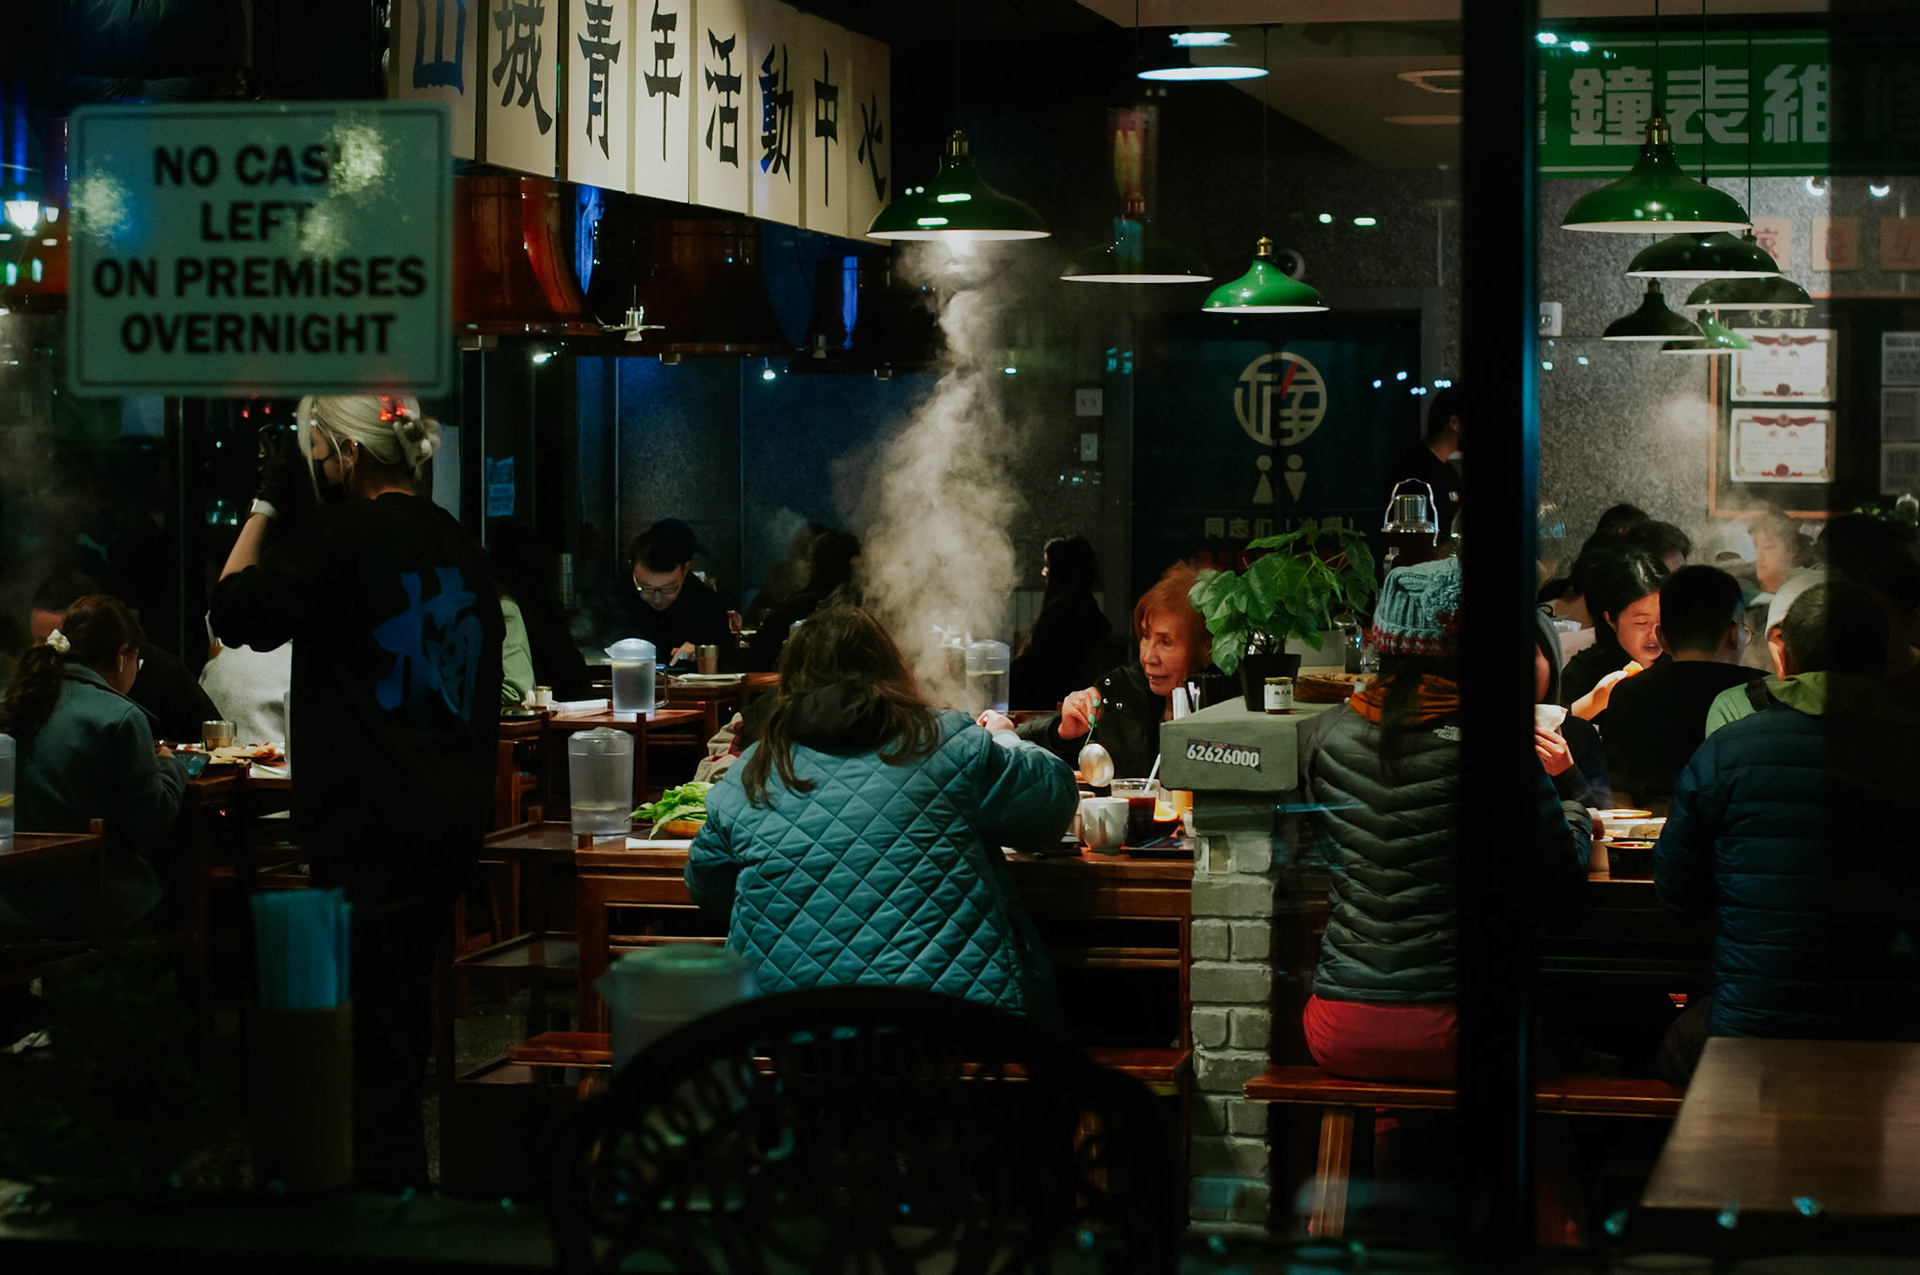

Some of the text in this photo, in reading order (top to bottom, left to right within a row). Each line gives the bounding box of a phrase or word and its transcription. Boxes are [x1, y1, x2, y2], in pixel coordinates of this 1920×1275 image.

[154, 145, 345, 187] NO CAS
[93, 256, 426, 298] ON PREMISES
[121, 313, 396, 354] OVERNIGHT
[1187, 744, 1260, 768] 62626000
